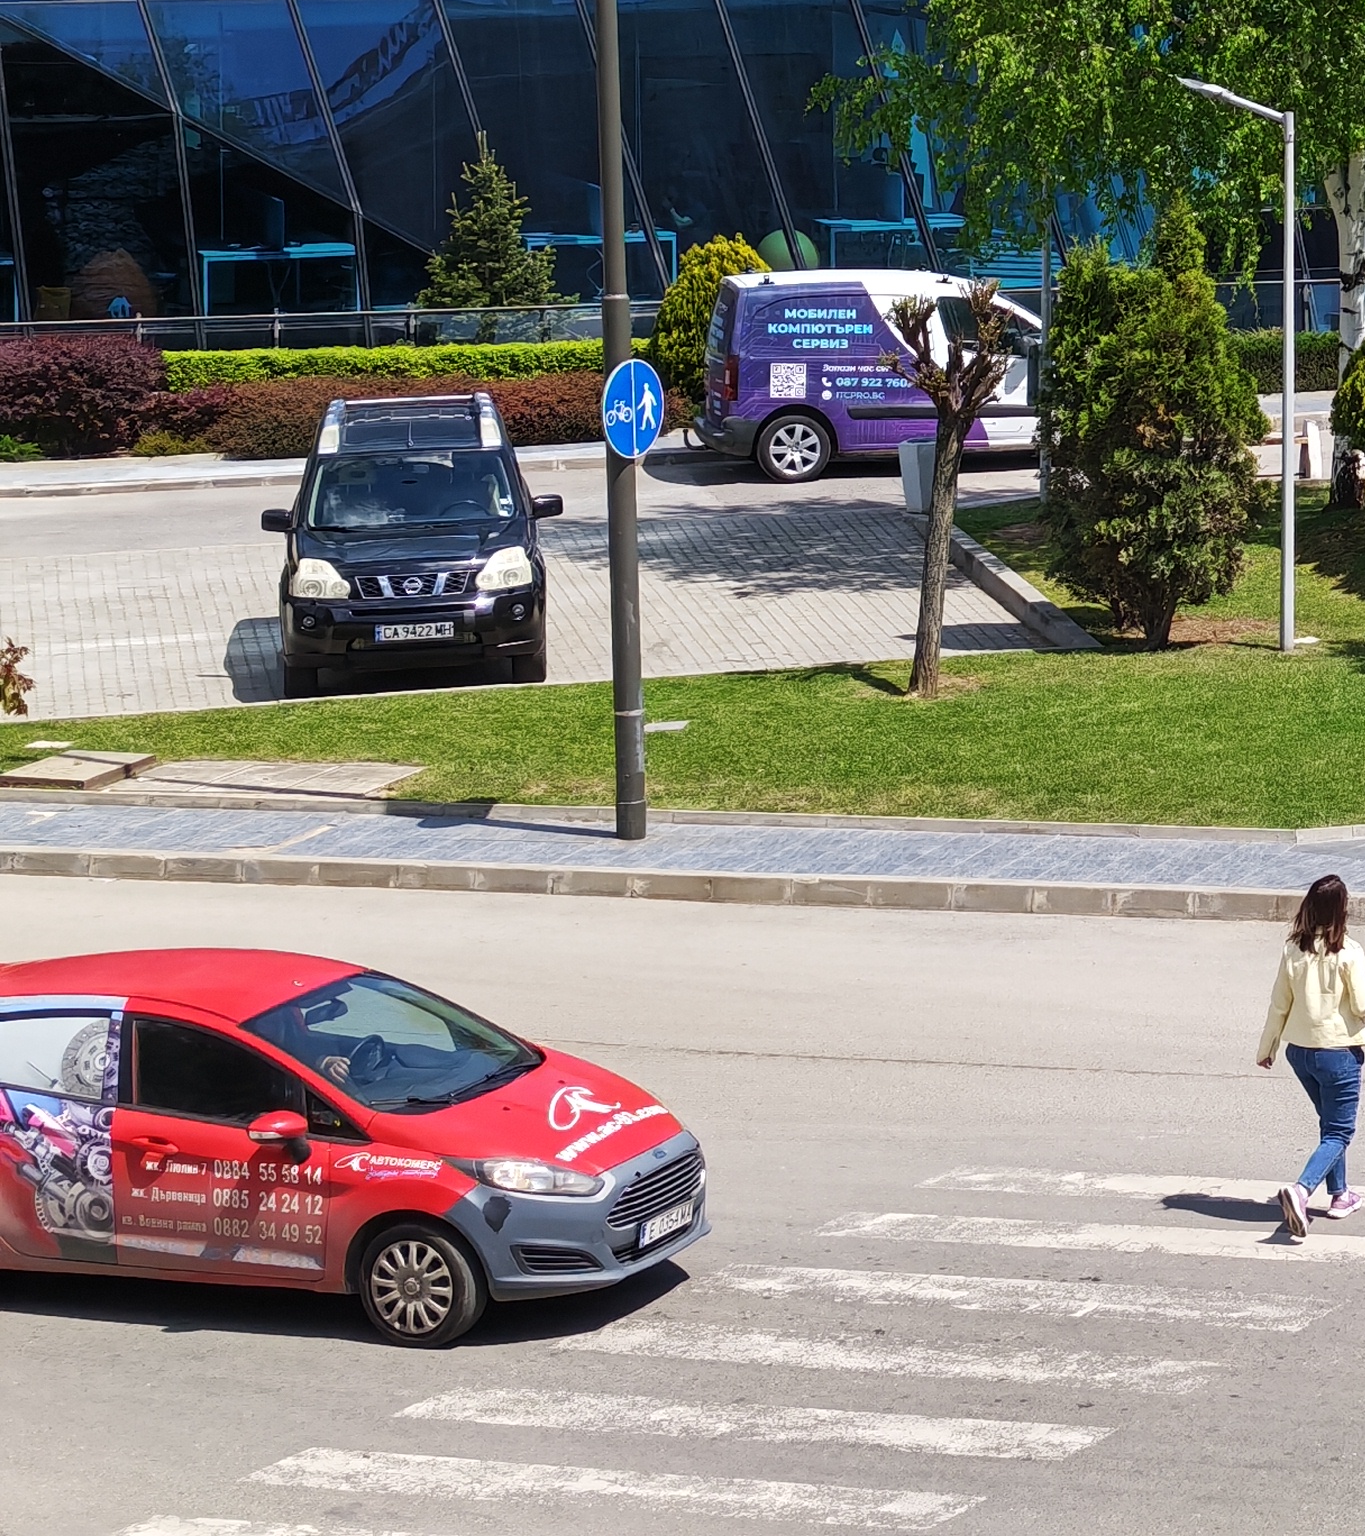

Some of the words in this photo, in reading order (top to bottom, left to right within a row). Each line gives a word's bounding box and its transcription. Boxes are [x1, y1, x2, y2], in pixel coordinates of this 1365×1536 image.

[784, 308, 857, 319] МОБИЛЕН
[767, 323, 873, 334] КОМПЮТЪРЕН
[792, 338, 849, 349] СЕРВИЗ
[835, 377, 859, 387] 087
[861, 377, 883, 387] 922
[383, 627, 400, 639] CA
[402, 625, 433, 639] 9422
[214, 1159, 250, 1180] 0884
[259, 1161, 277, 1182] 55
[281, 1164, 299, 1184] 58
[304, 1166, 323, 1186] 14
[213, 1187, 250, 1209] 0885
[258, 1191, 277, 1212] 24
[281, 1192, 299, 1214] 24
[305, 1195, 323, 1216] 12
[213, 1217, 250, 1239] 0882
[259, 1221, 277, 1241] 34
[281, 1221, 299, 1243] 49
[305, 1225, 323, 1245] 52
